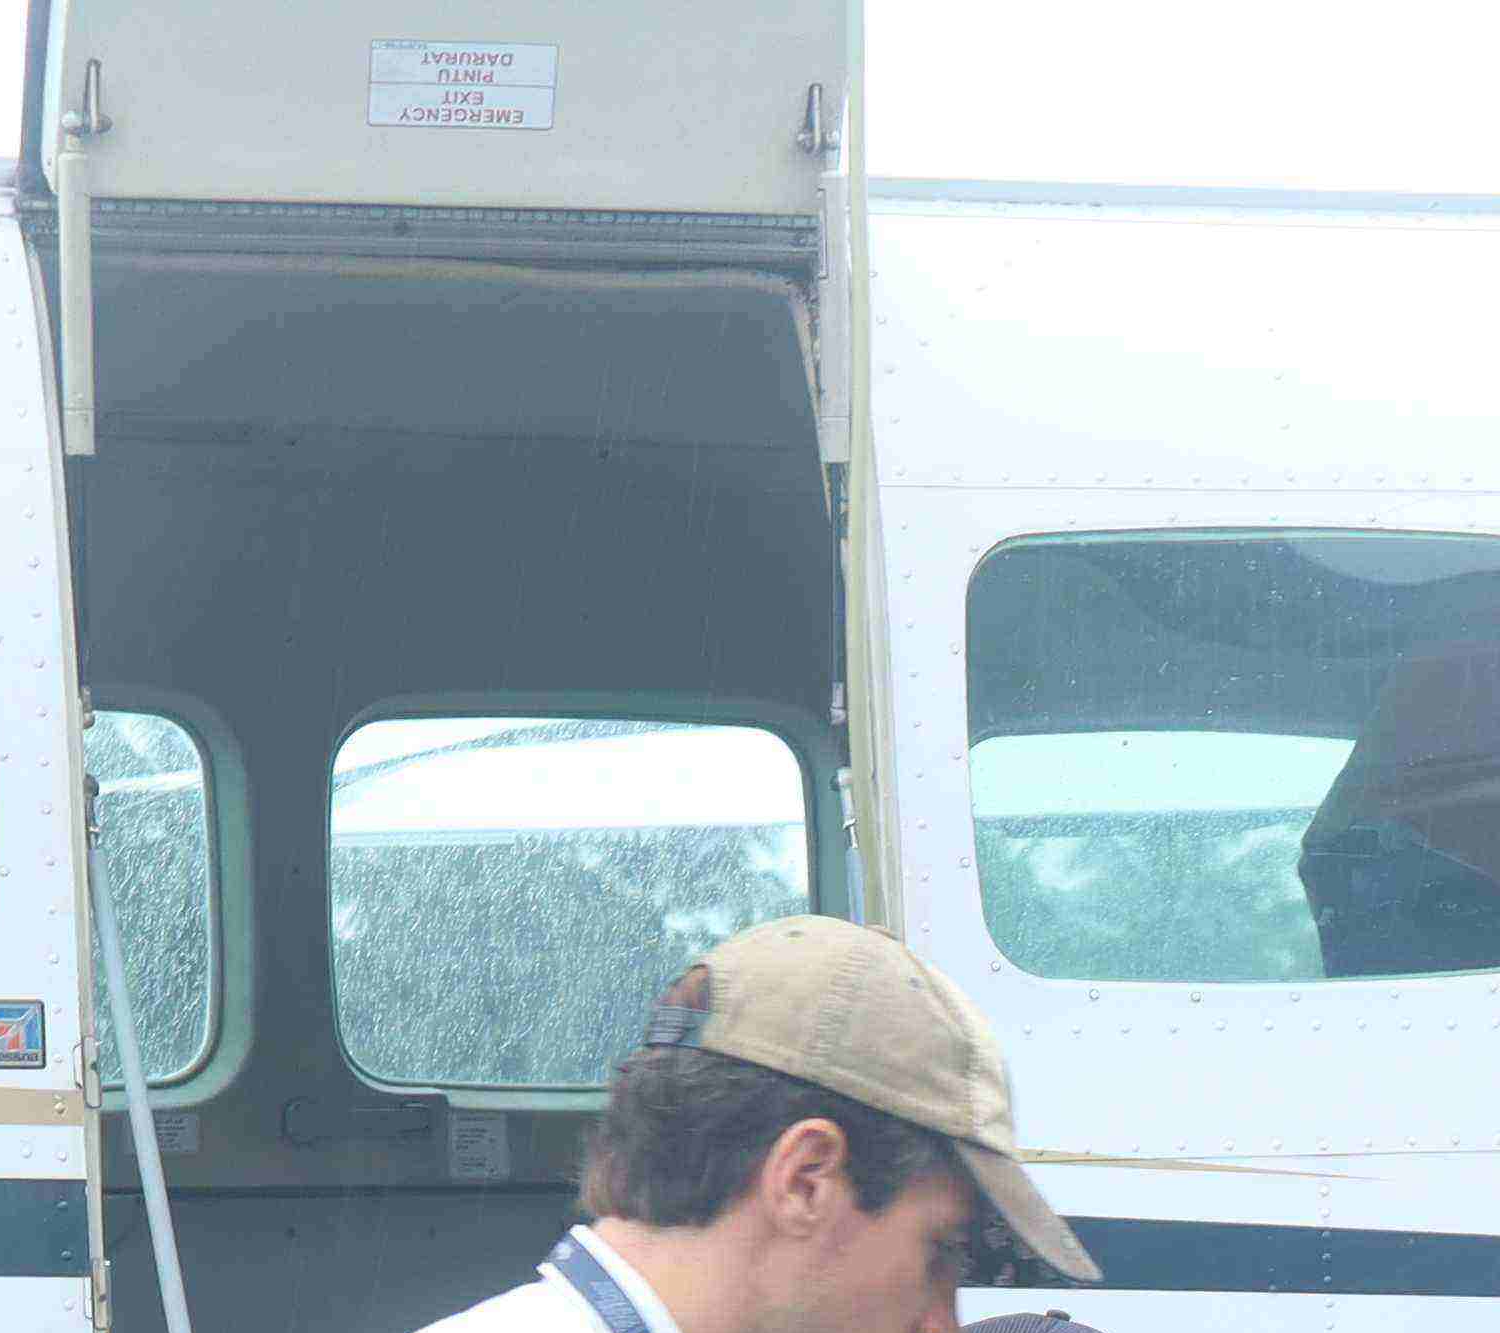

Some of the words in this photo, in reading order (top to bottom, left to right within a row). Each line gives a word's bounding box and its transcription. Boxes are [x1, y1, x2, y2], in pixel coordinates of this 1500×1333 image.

[420, 51, 514, 67] DARURAT
[437, 68, 495, 84] PINTU
[442, 90, 485, 105] EXIT
[399, 107, 525, 124] EMERGENCY
